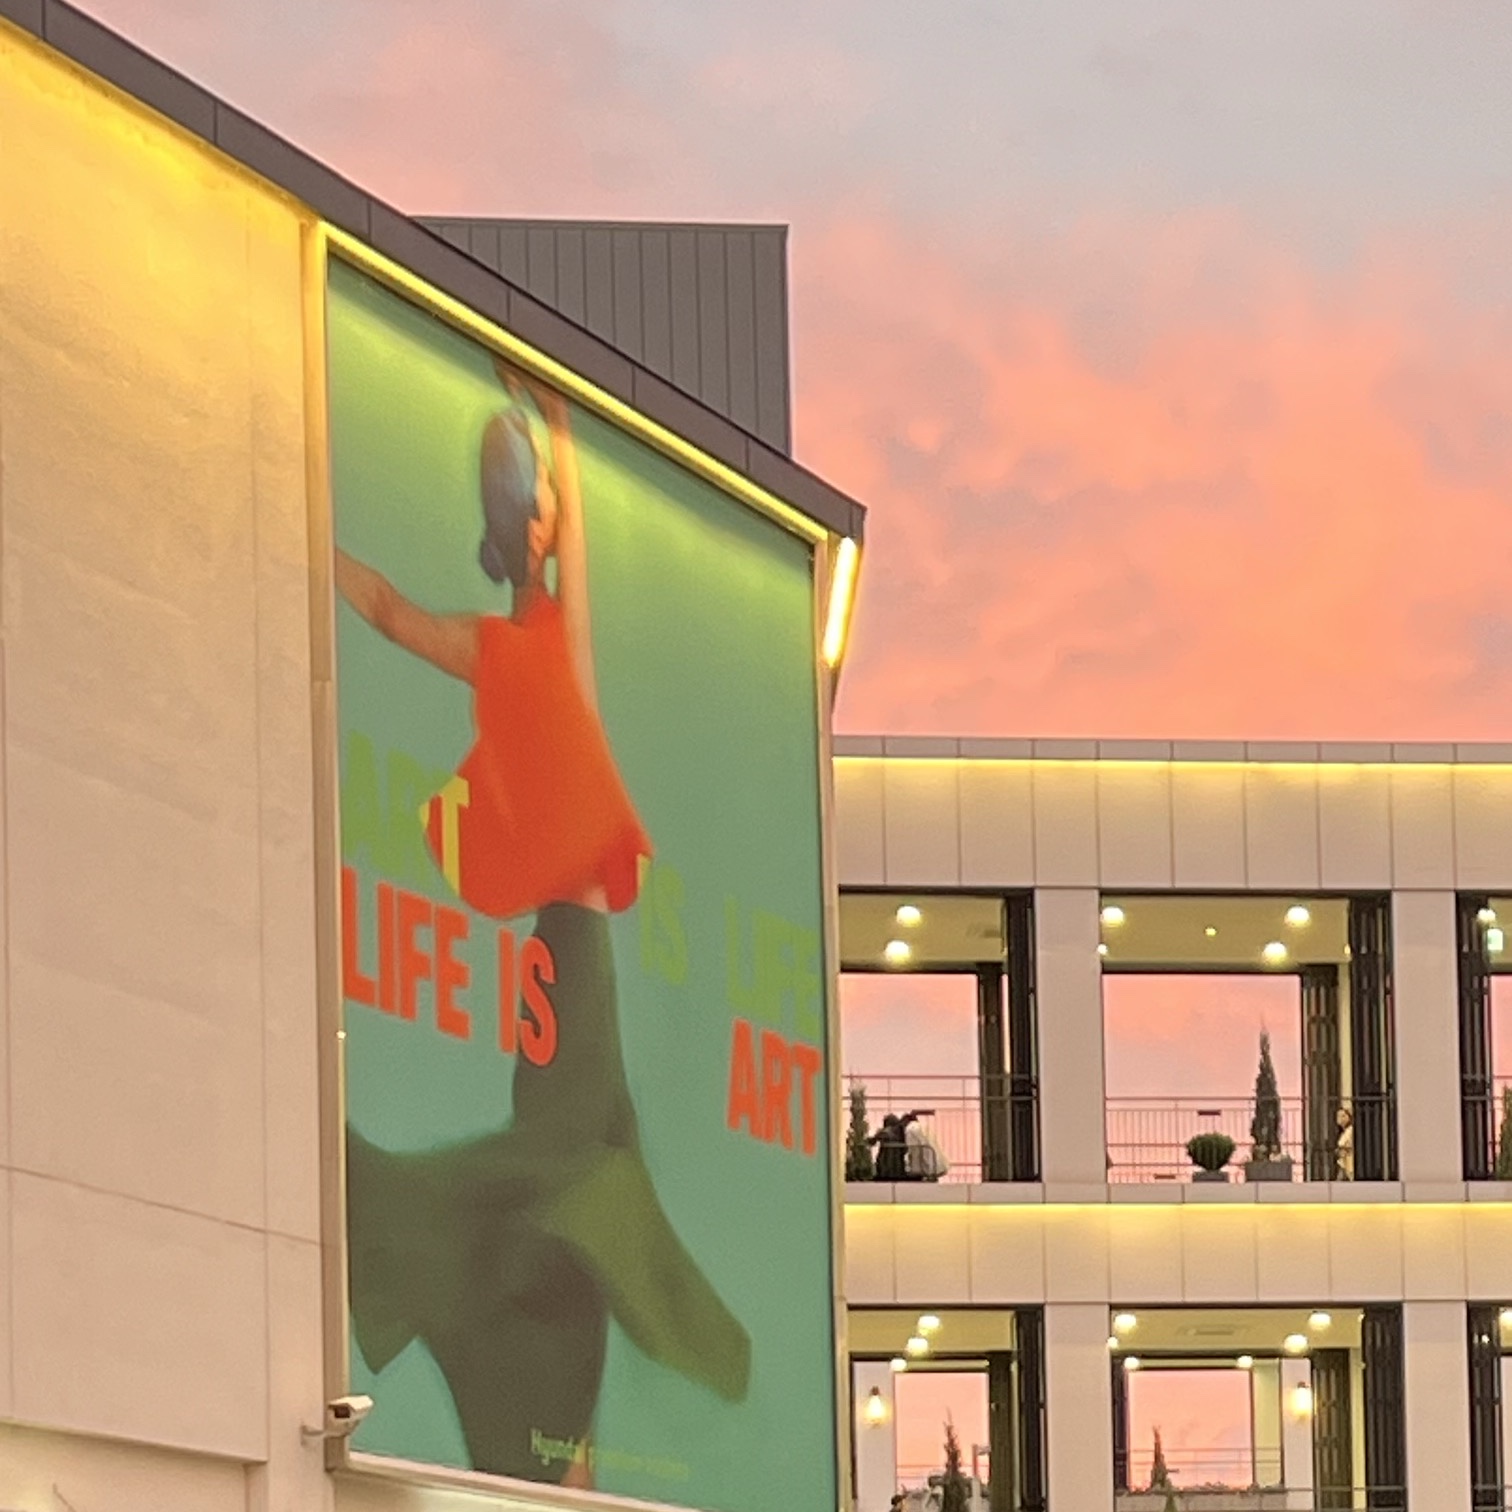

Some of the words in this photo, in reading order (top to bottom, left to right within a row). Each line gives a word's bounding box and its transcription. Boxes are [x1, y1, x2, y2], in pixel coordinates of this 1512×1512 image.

[341, 864, 471, 1040] LIFE
[498, 927, 558, 1066] IS
[726, 1015, 822, 1158] ART
